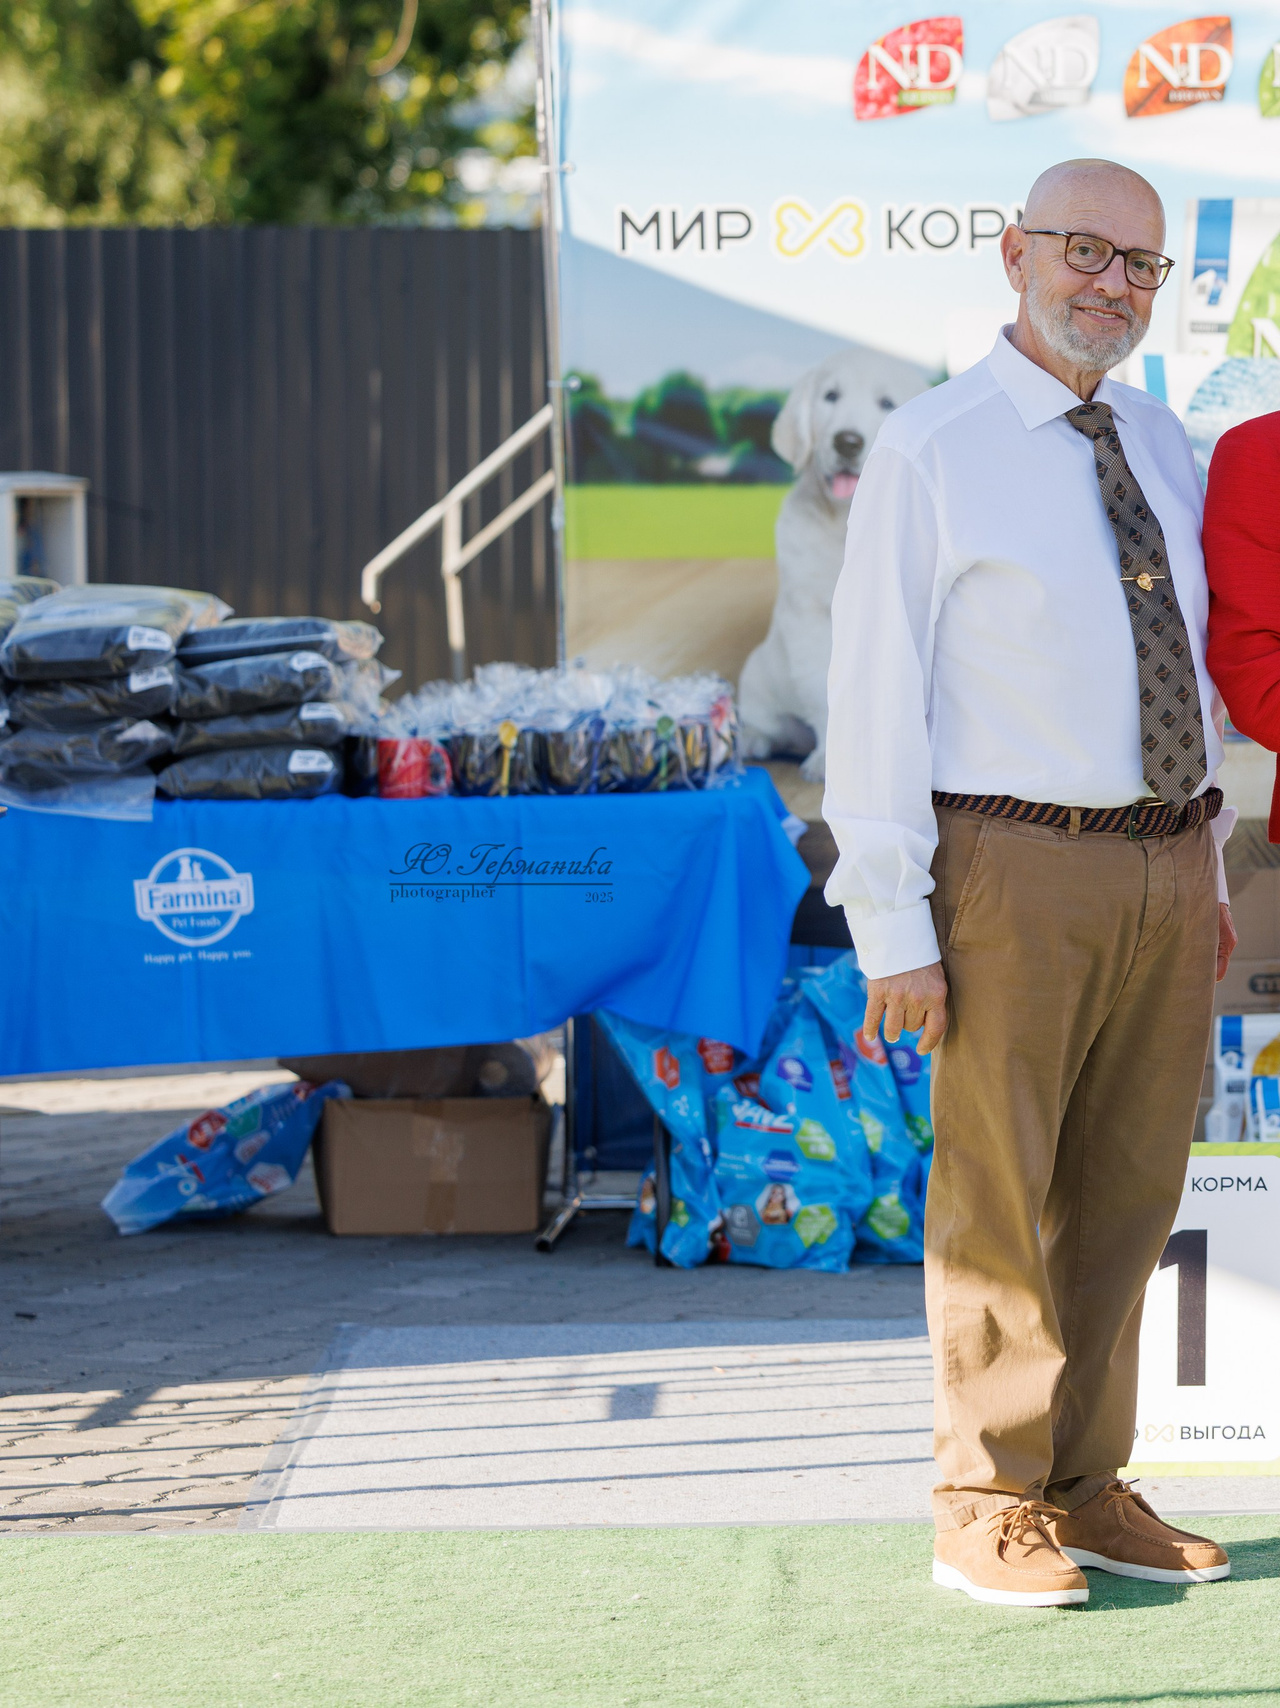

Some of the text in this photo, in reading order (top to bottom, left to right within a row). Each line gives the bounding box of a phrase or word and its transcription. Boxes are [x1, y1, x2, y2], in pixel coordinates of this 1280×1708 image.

[621, 209, 1025, 251] МИР КОР
[149, 885, 241, 910] Farmina
[1192, 1177, 1268, 1192] КОРМА
[1158, 1229, 1208, 1386] 1
[1181, 1426, 1266, 1442] ВЫГОДА
